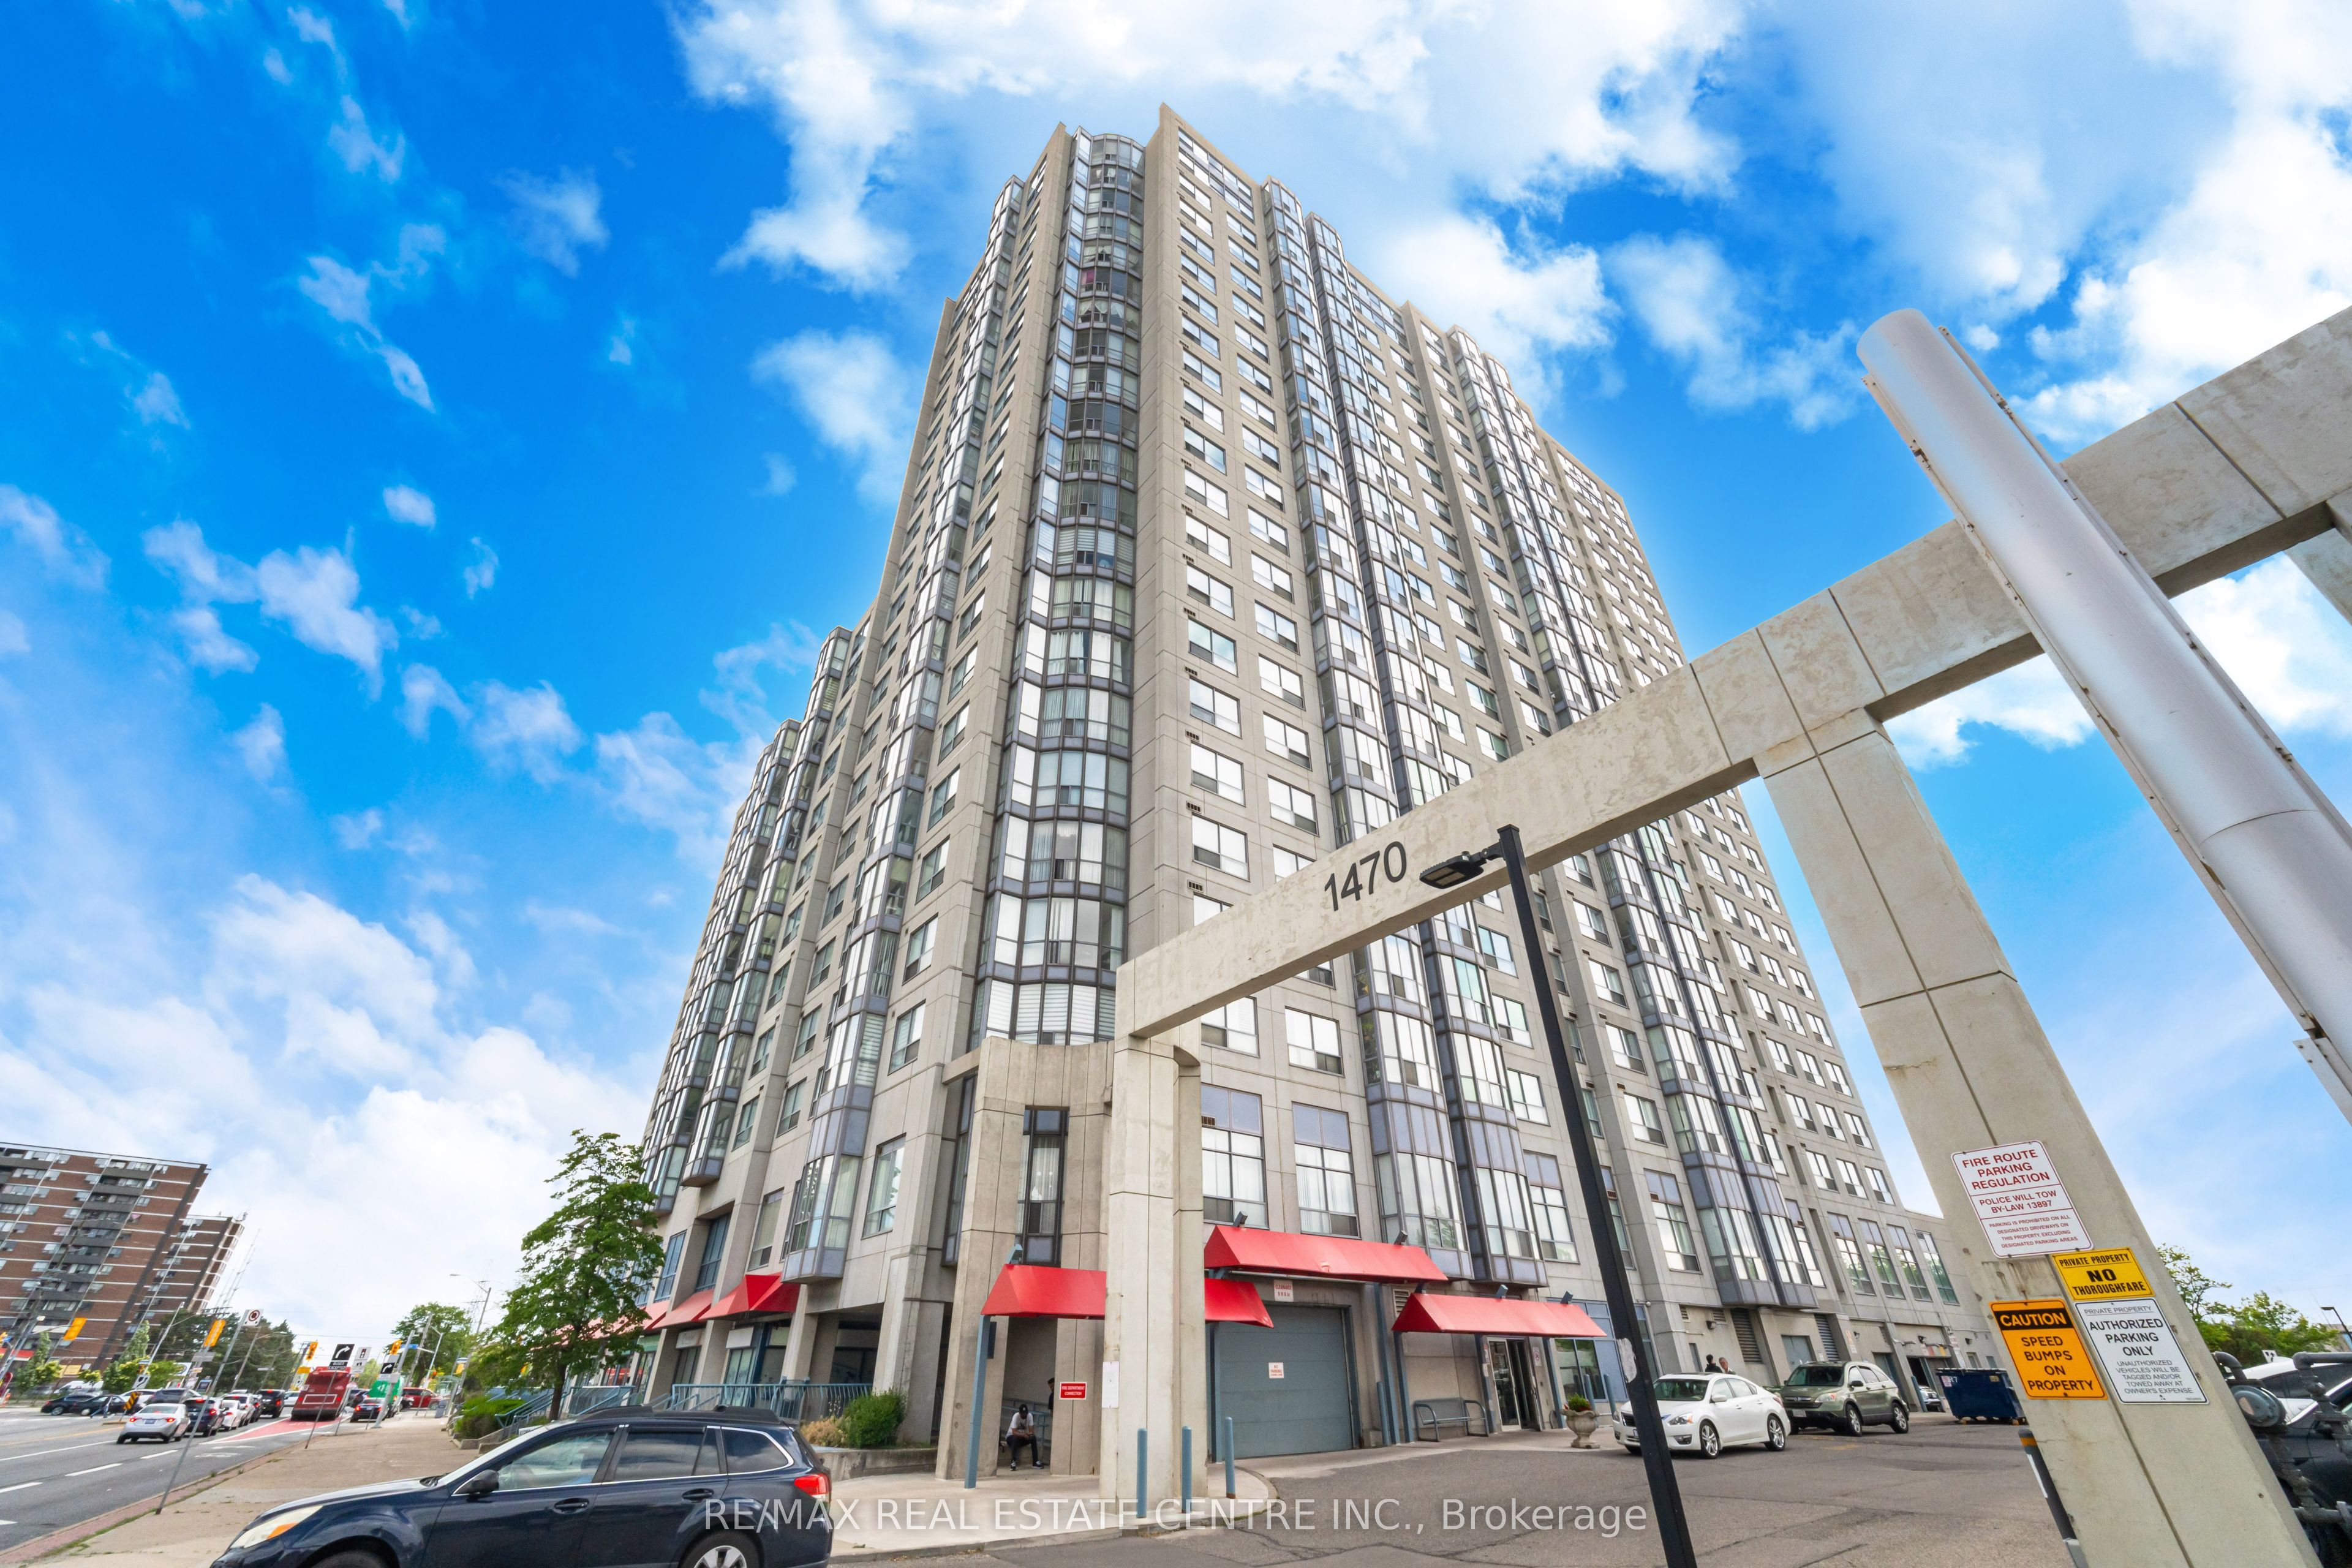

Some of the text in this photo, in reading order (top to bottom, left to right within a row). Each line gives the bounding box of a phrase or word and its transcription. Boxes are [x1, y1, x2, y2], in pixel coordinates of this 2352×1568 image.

[1324, 841, 1407, 911] 1470
[1962, 1150, 2038, 1168] FIRE ROUTE
[1977, 1162, 2032, 1177] PARKING
[1972, 1172, 2049, 1190] REGULATION
[1979, 1196, 2011, 1205] POLICE
[2035, 1190, 2057, 1199] TOW
[1991, 1200, 2052, 1213] BY-LAW 13897
[2059, 1253, 2130, 1267] PRIVATE PROPERTY
[2086, 1268, 2117, 1283] NO
[2072, 1281, 2146, 1295] THOROUGHFARE
[2000, 1313, 2067, 1327] CAUTION
[2090, 1318, 2163, 1330] AUTHORIZED
[2021, 1336, 2063, 1346] SPEED
[2105, 1332, 2159, 1343] PARKING
[2024, 1351, 2073, 1361] BUMPS
[2122, 1346, 2154, 1356] ONLY
[2044, 1365, 2066, 1375] ON
[2027, 1380, 2094, 1390] PROPERTY
